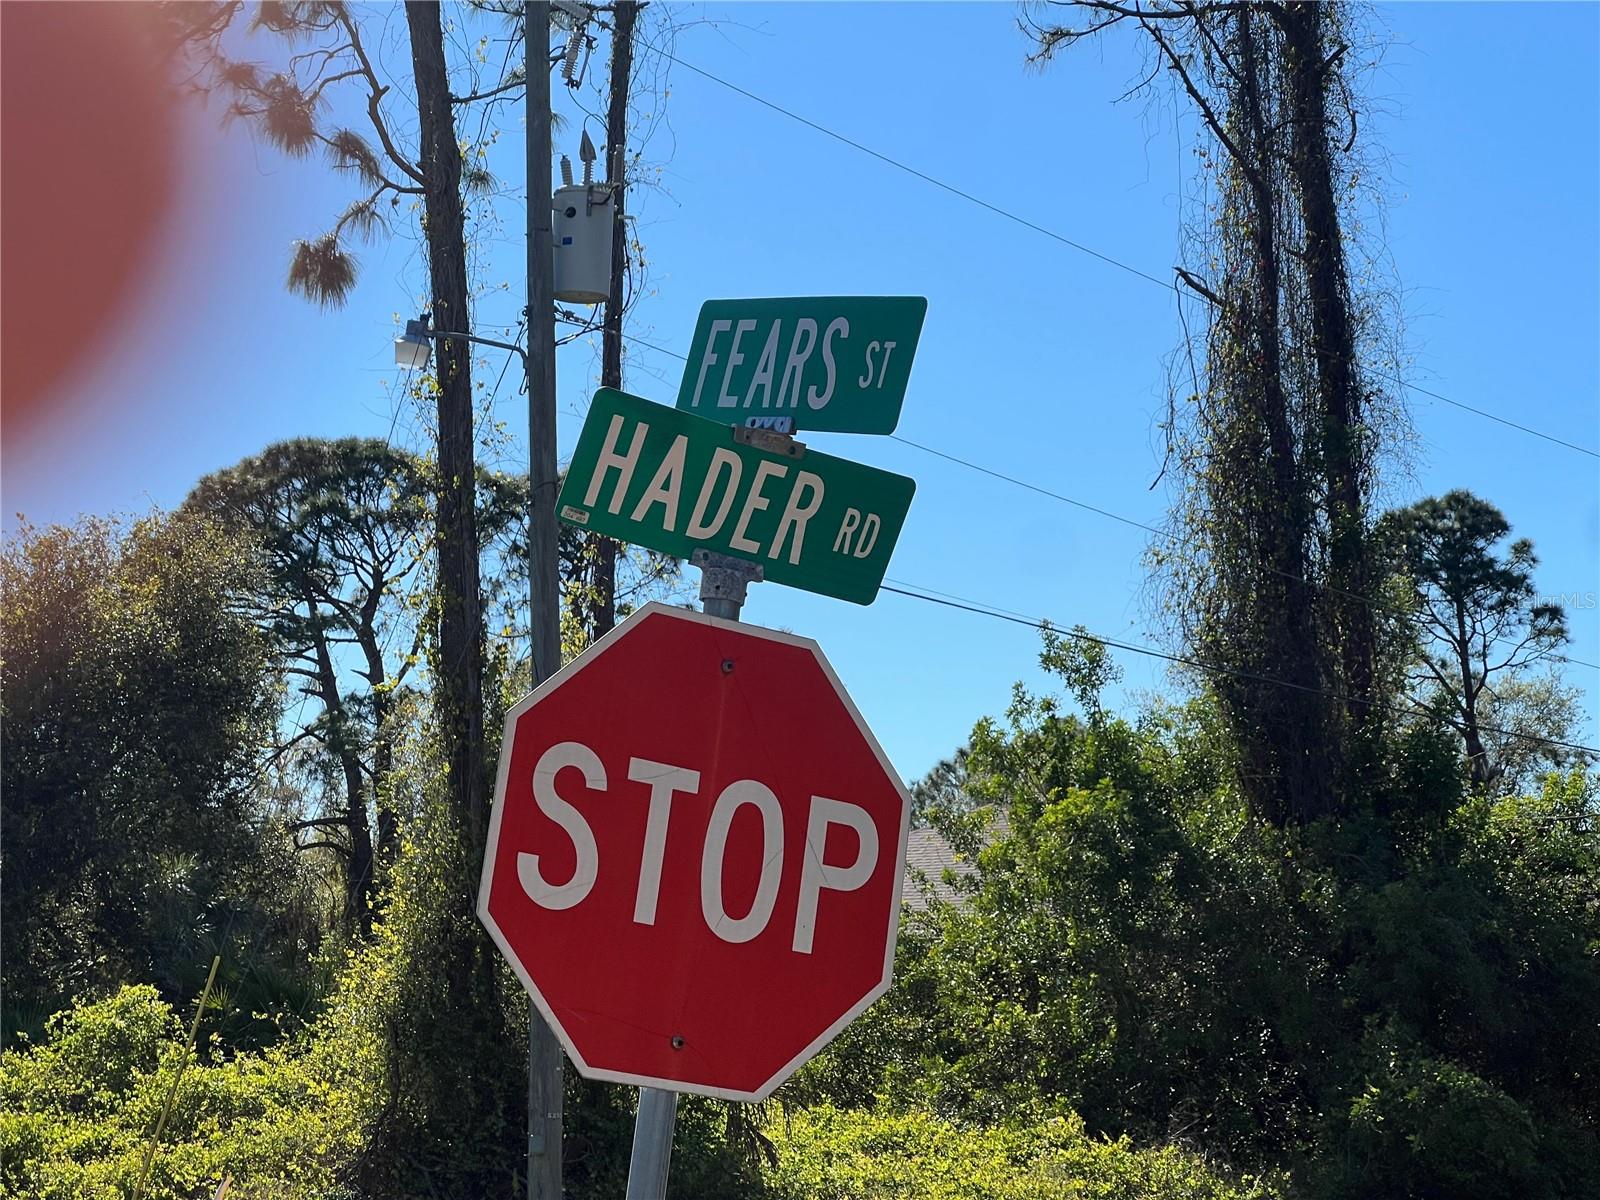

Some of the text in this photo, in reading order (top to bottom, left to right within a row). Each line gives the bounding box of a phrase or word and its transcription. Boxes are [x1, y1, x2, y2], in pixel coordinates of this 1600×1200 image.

[691, 316, 897, 410] FEARS ST
[583, 414, 881, 566] HADER RD
[516, 741, 879, 954] STOP
